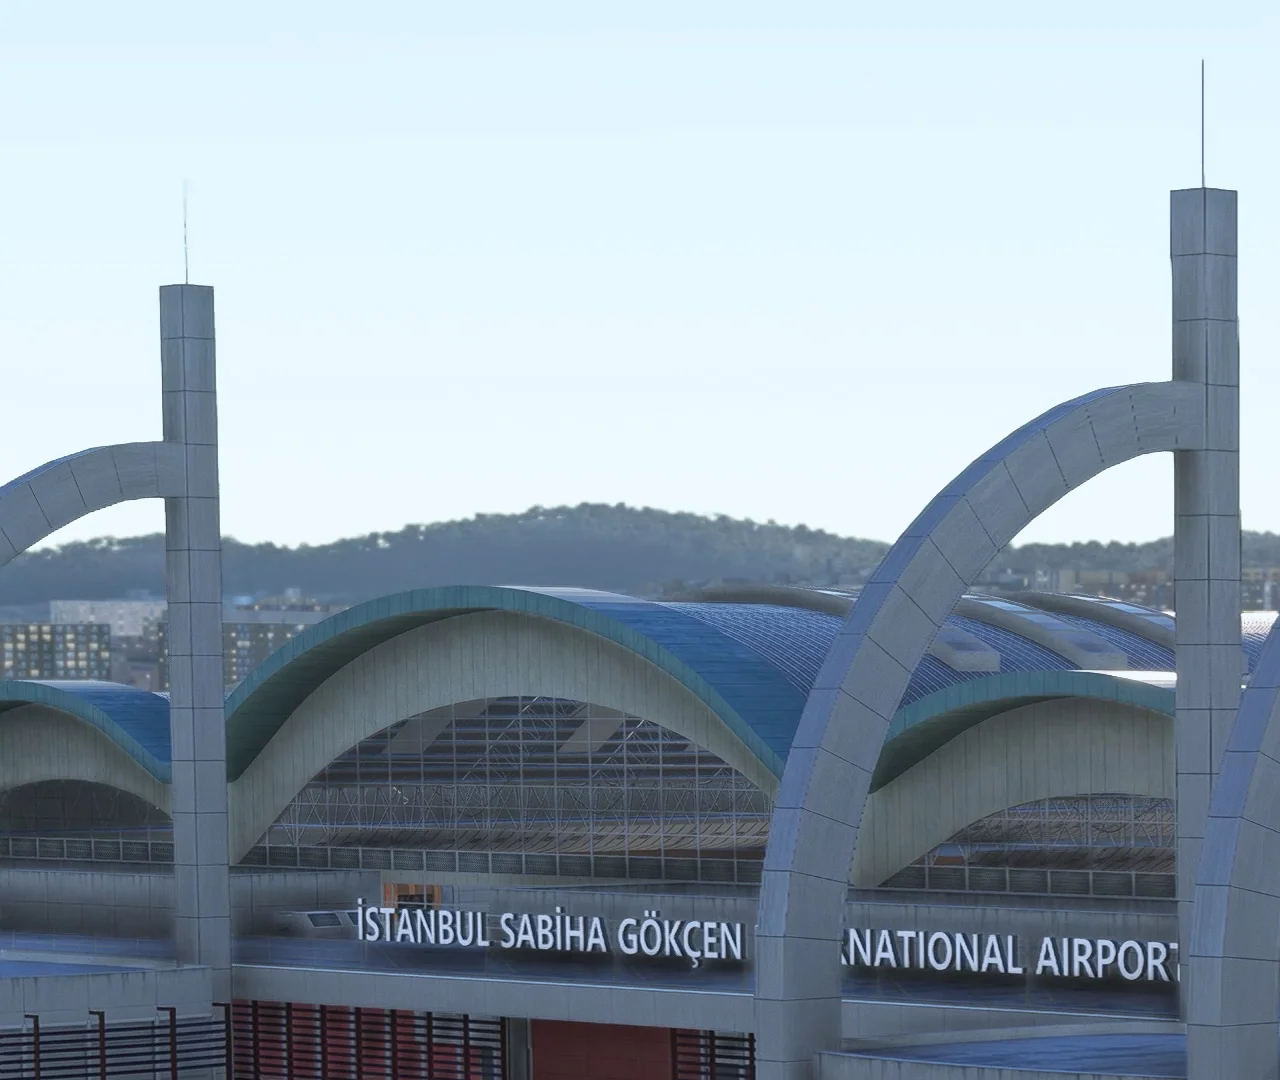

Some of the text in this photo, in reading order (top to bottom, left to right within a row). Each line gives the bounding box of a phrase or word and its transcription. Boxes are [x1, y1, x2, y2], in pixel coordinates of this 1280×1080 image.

[356, 898, 490, 949] İSTANBUL
[500, 906, 608, 955] SABİHA
[617, 910, 744, 969] GÖKÇEN
